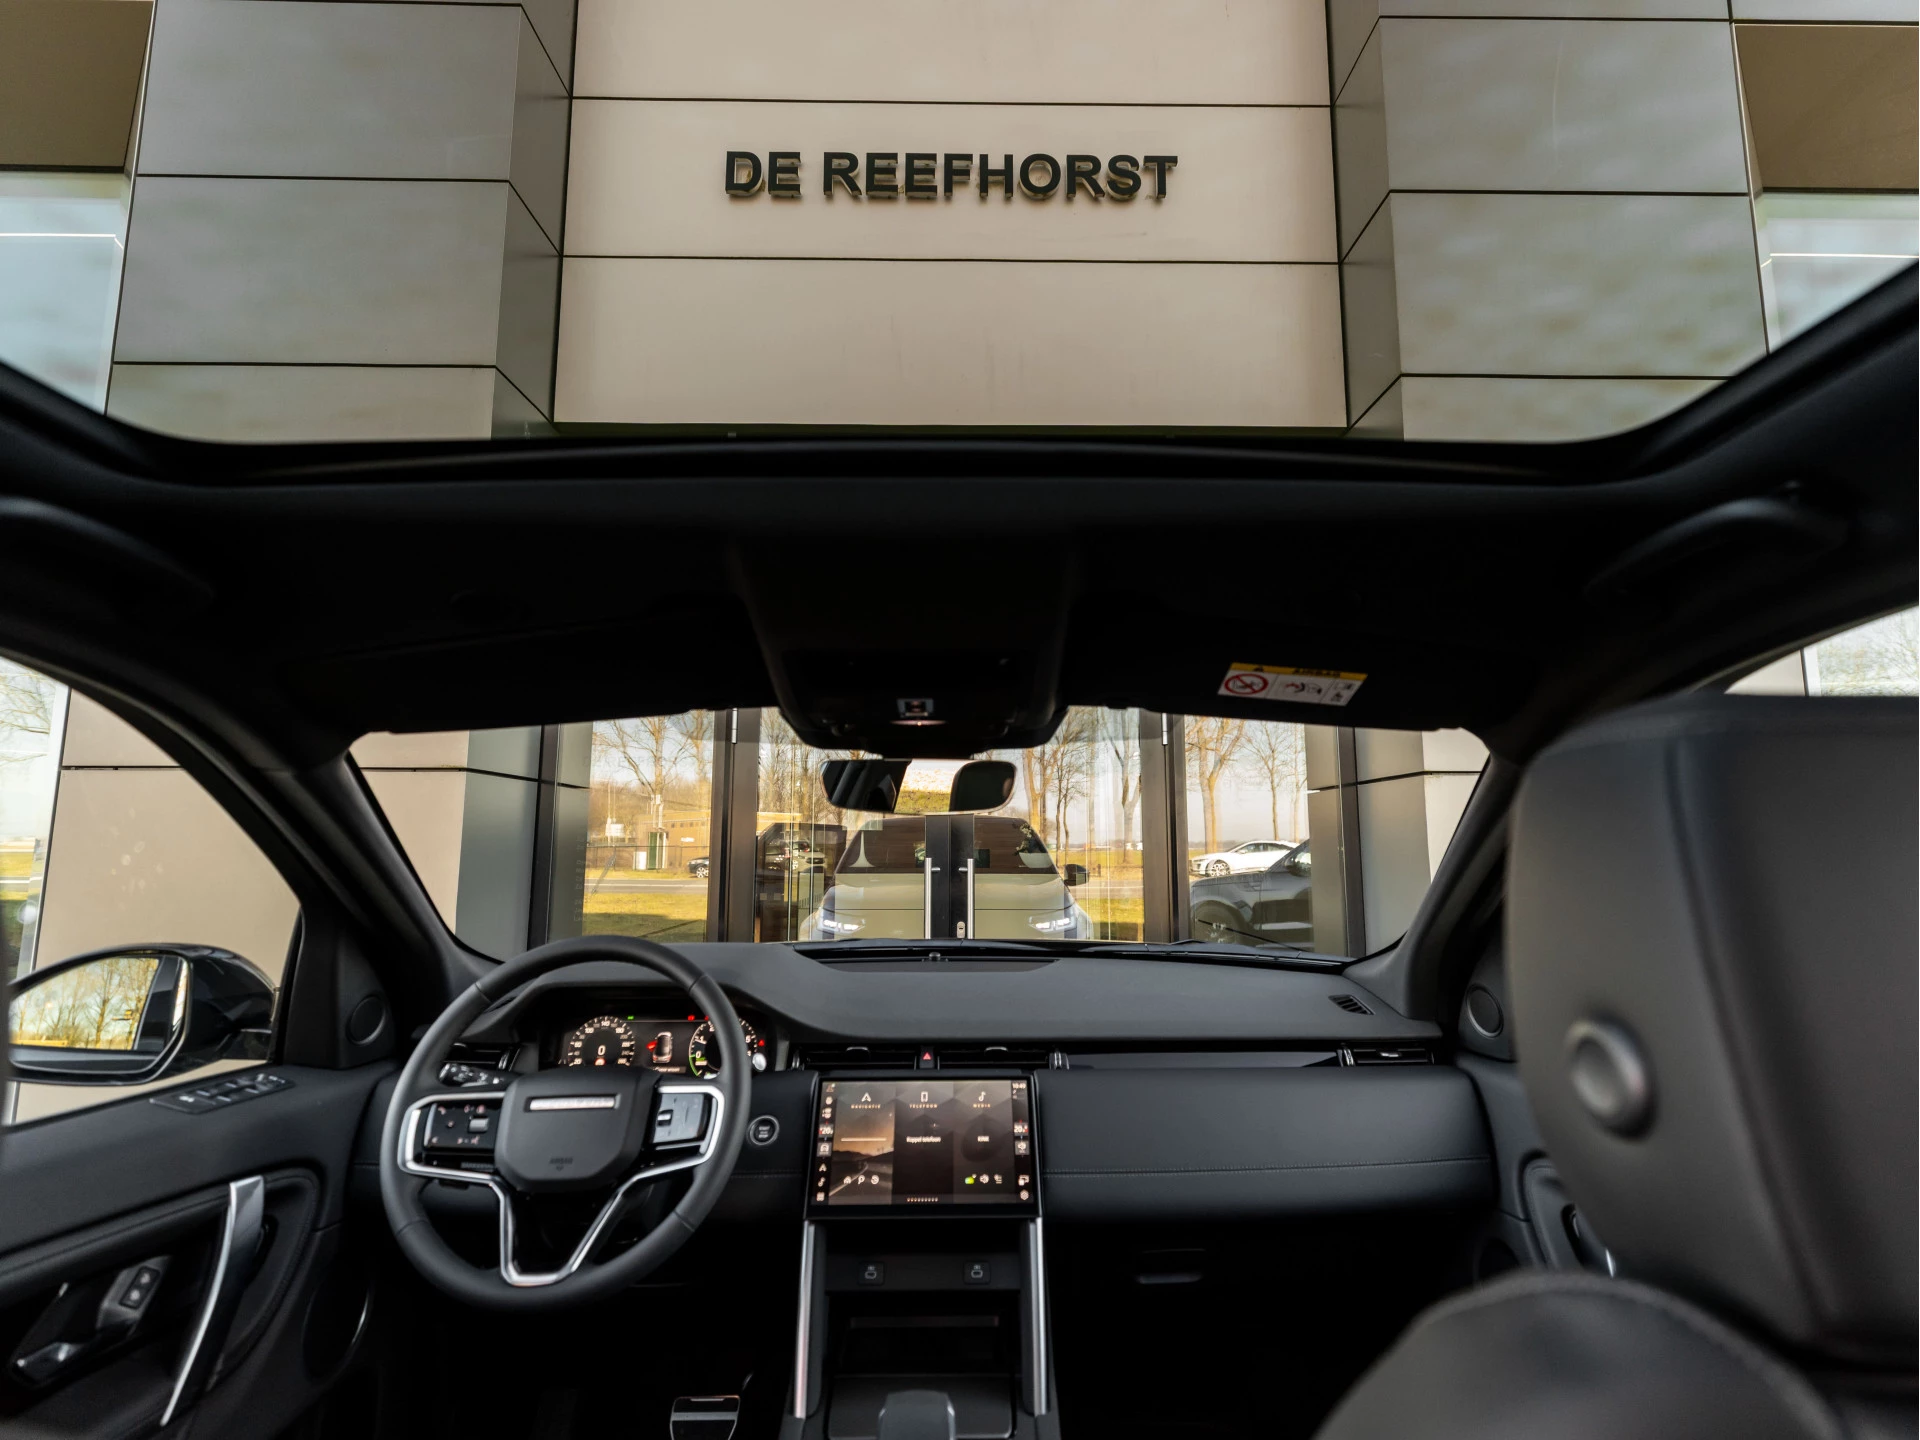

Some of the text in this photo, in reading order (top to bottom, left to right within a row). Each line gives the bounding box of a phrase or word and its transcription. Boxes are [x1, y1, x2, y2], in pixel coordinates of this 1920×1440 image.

[725, 150, 1179, 201] DE REEFHORST
[597, 1045, 606, 1056] 0
